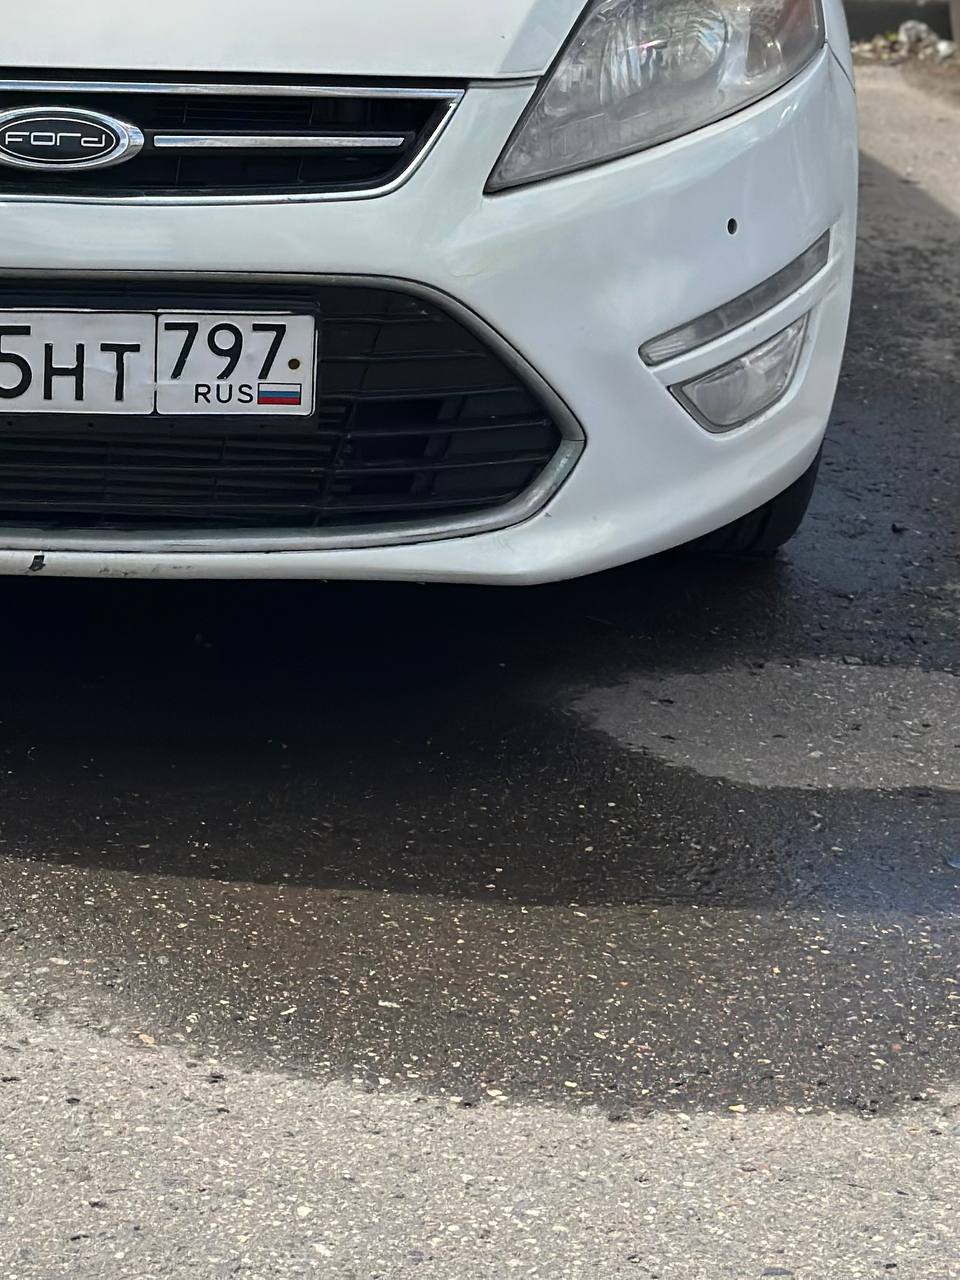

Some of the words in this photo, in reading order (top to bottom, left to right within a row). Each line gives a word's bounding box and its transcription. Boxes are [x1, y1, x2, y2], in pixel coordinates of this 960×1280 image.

[5, 131, 106, 147] Ford
[163, 321, 287, 381] 797
[194, 383, 254, 405] RUS
